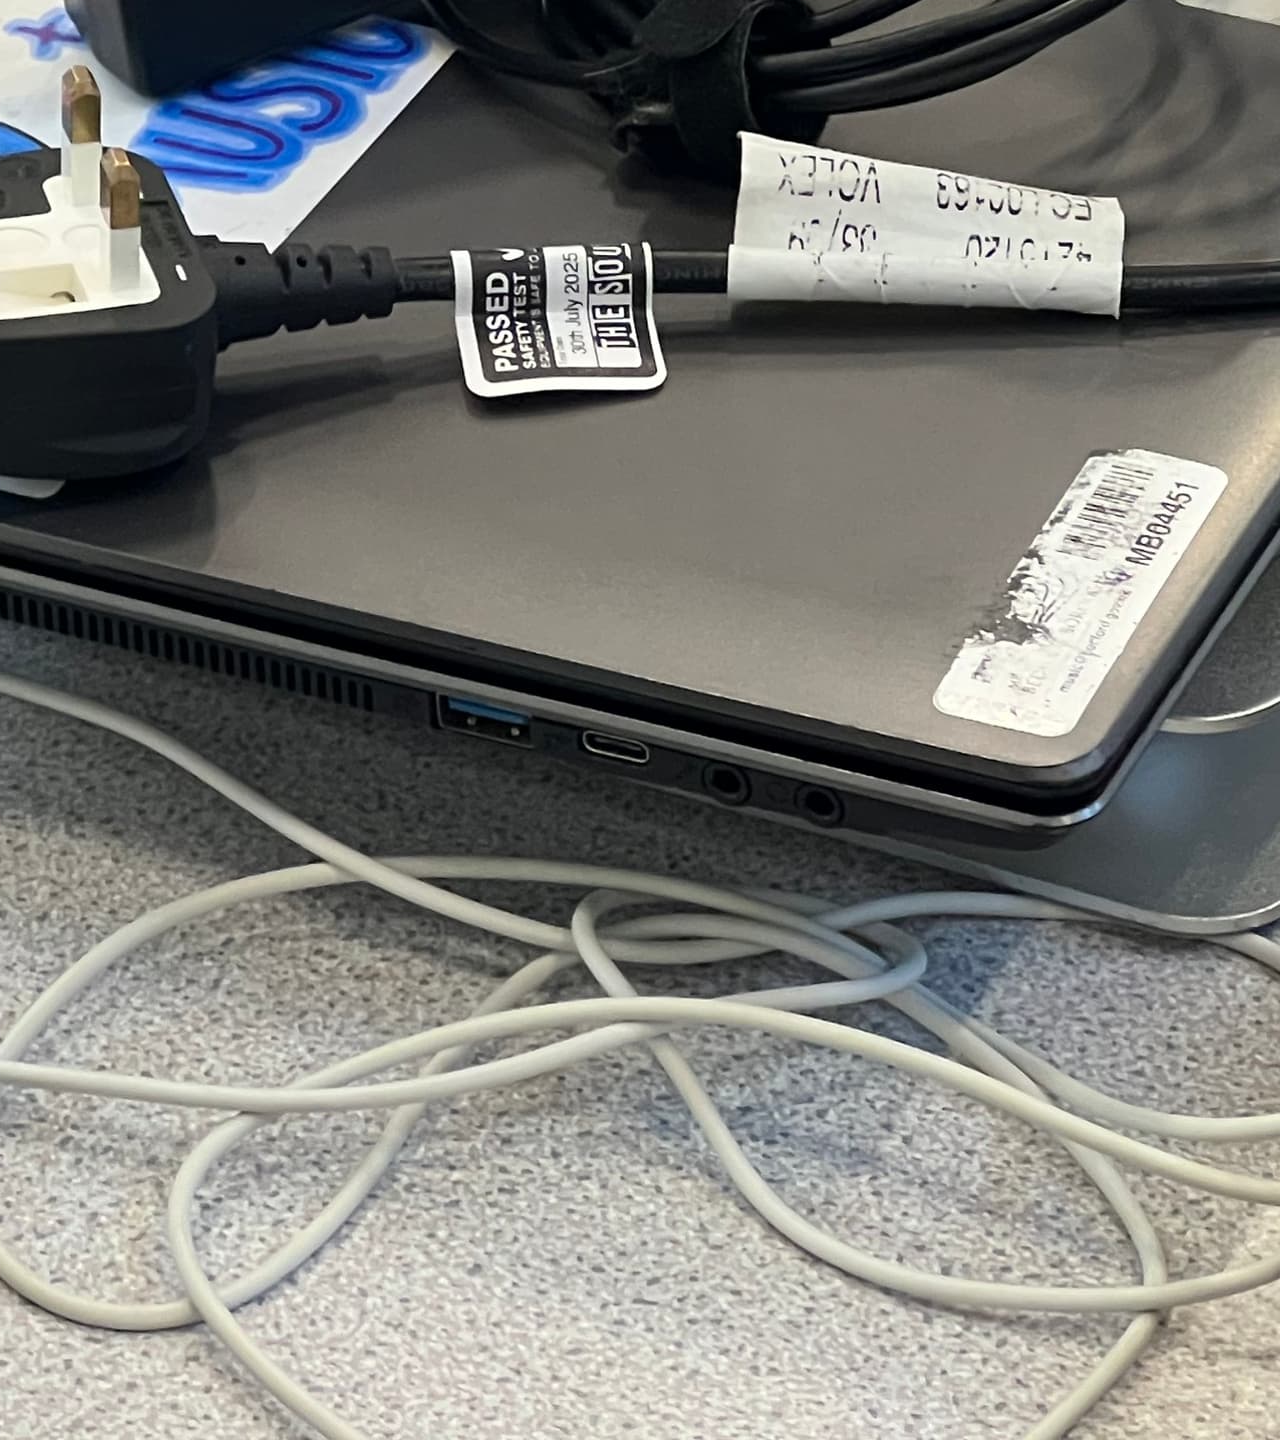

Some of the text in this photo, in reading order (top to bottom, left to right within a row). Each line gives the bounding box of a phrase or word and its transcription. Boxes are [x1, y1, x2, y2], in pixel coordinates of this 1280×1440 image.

[778, 153, 881, 203] VOLEX
[486, 271, 519, 372] PASSED
[513, 271, 536, 370] SAFETY TEST
[562, 252, 588, 355] 30th July 2025
[596, 306, 632, 348] THE
